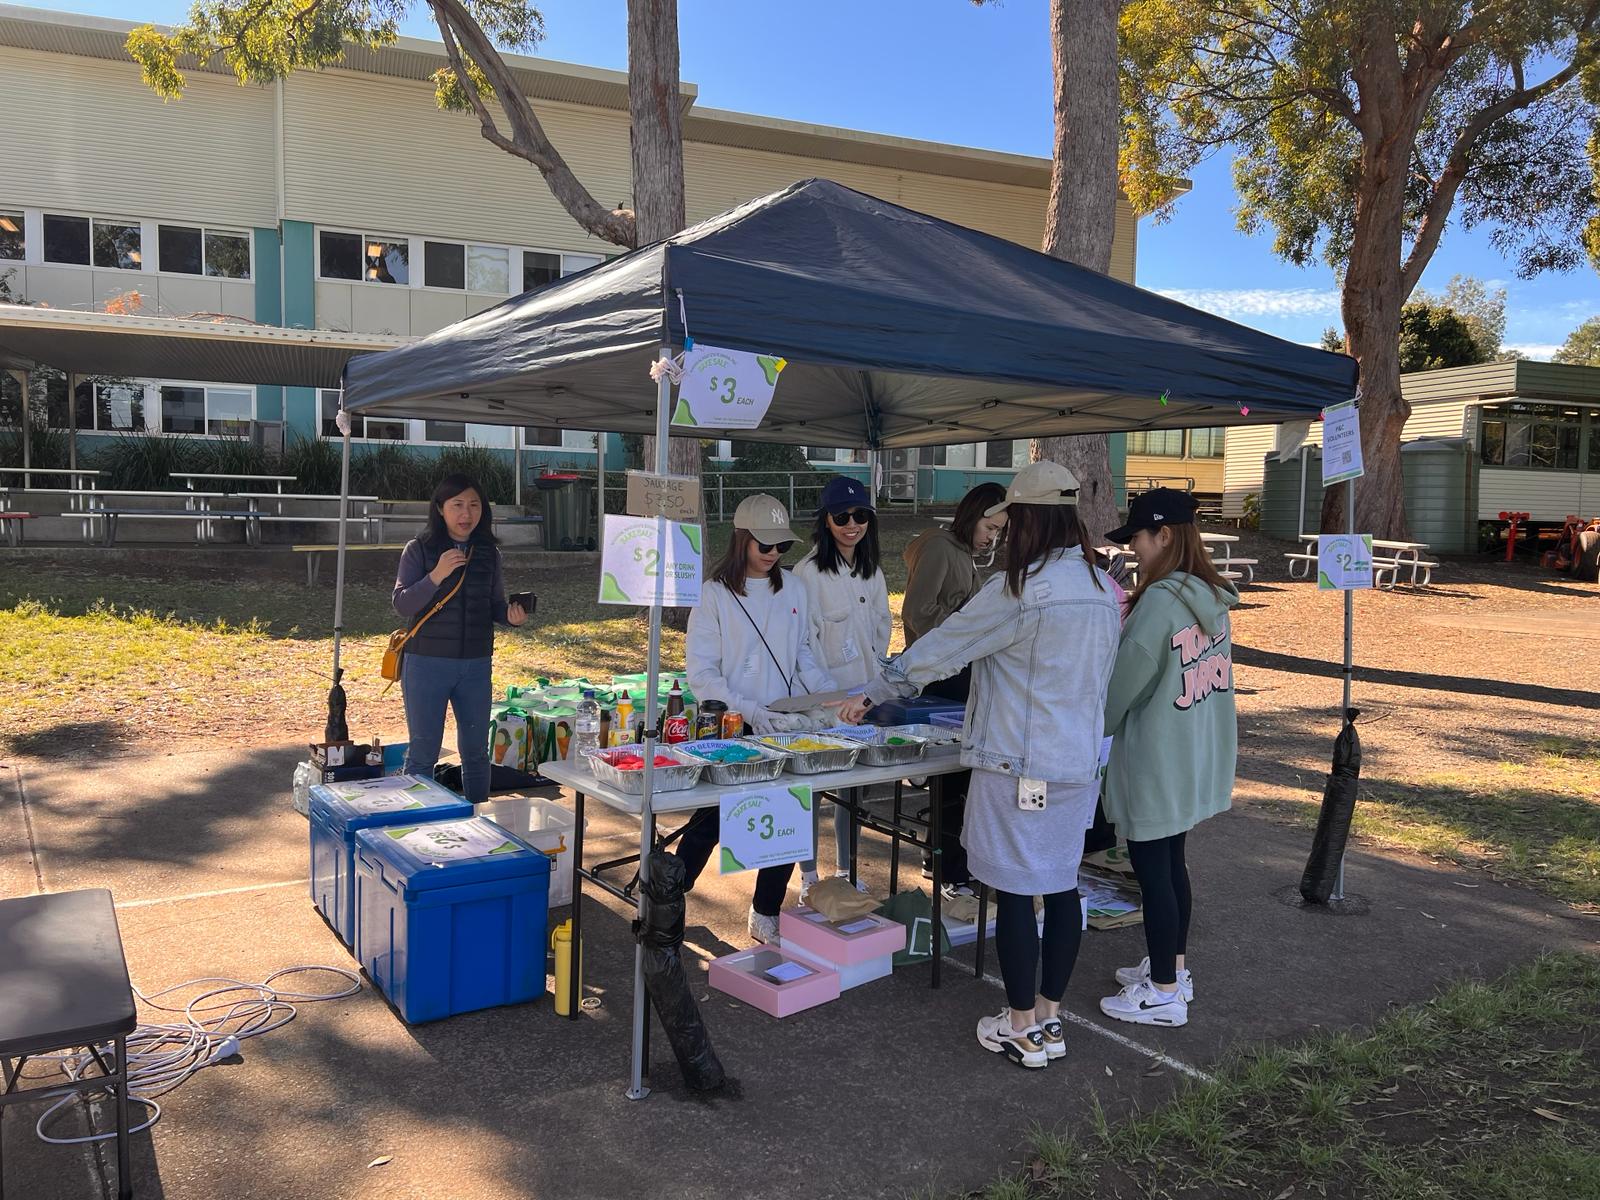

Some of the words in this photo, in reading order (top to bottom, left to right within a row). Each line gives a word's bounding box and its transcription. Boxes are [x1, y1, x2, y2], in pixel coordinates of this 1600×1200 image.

[736, 397, 755, 406] EACH
[1327, 430, 1355, 442] VOLUNTEERS
[771, 508, 785, 524] NY
[665, 562, 679, 571] ANY
[679, 563, 695, 571] DRINK
[674, 571, 696, 579] SLUSHY
[777, 828, 795, 837] EACH
